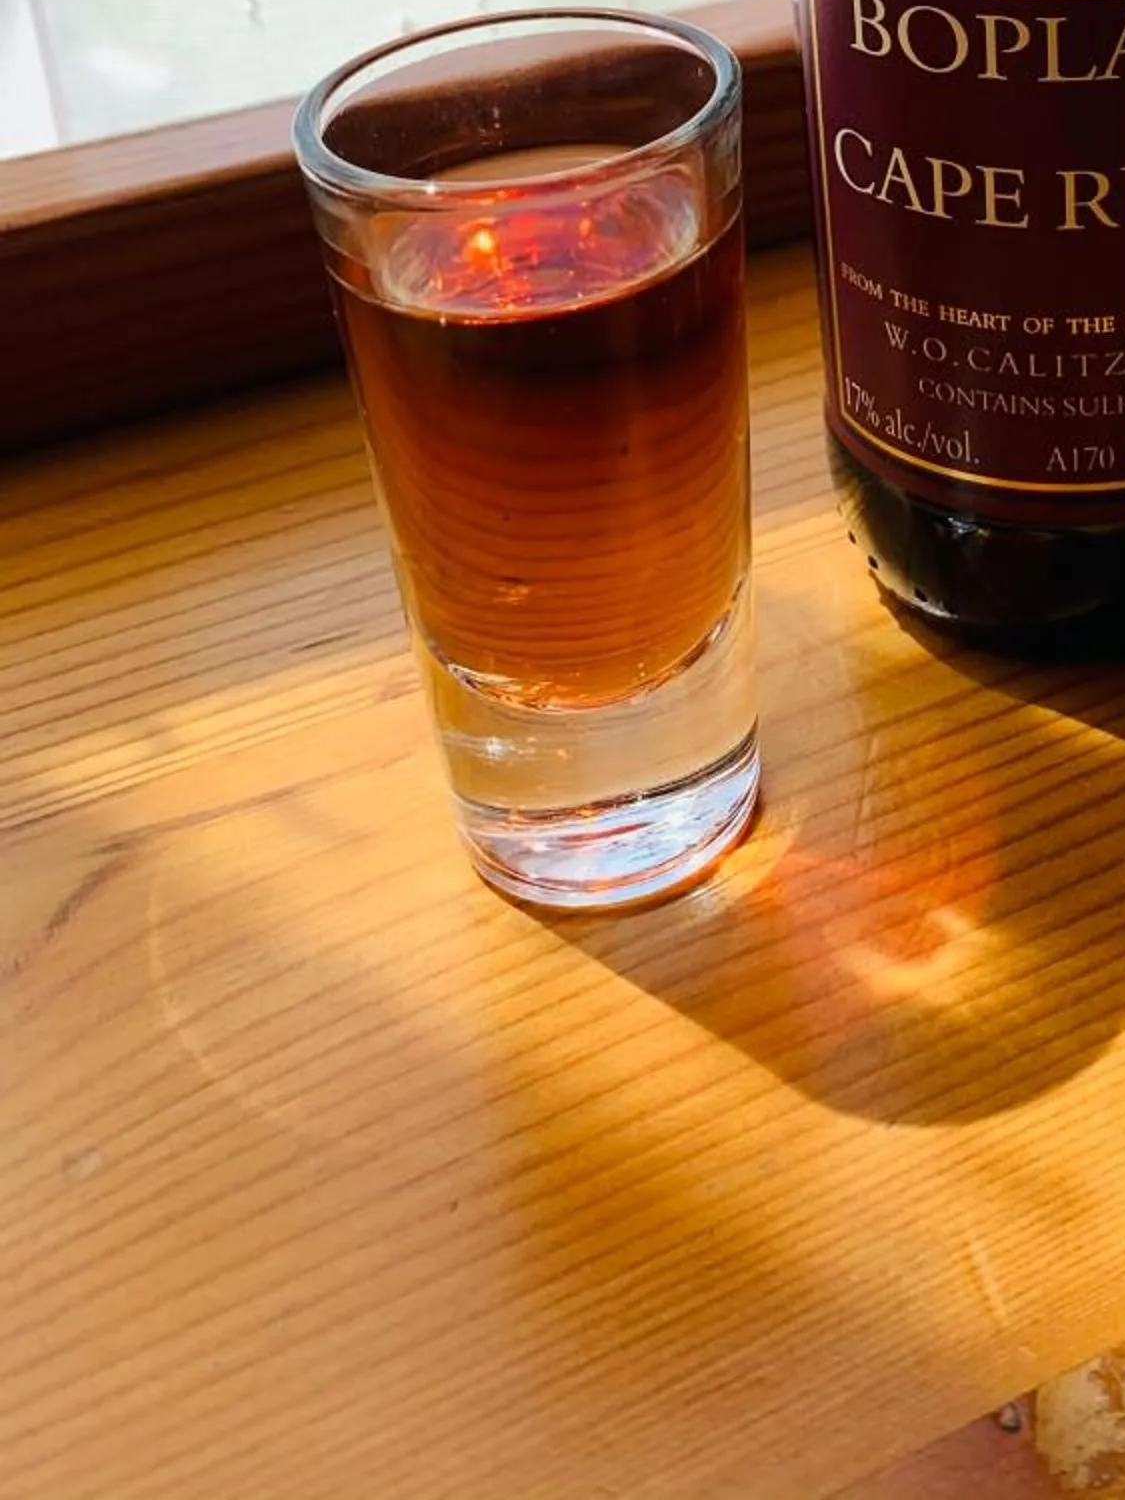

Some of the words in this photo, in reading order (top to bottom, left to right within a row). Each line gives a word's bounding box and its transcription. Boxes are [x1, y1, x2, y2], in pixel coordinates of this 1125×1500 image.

[834, 127, 1029, 230] CAPE
[841, 262, 883, 299] FROM
[889, 289, 930, 317] THE
[939, 304, 1012, 332] HEART
[1023, 317, 1054, 335] OF
[1066, 315, 1115, 335] THE
[845, 376, 880, 427] 17%
[885, 408, 980, 465] alc./vol.
[919, 378, 1054, 415] CONTAINS
[1046, 446, 1115, 473] A170
